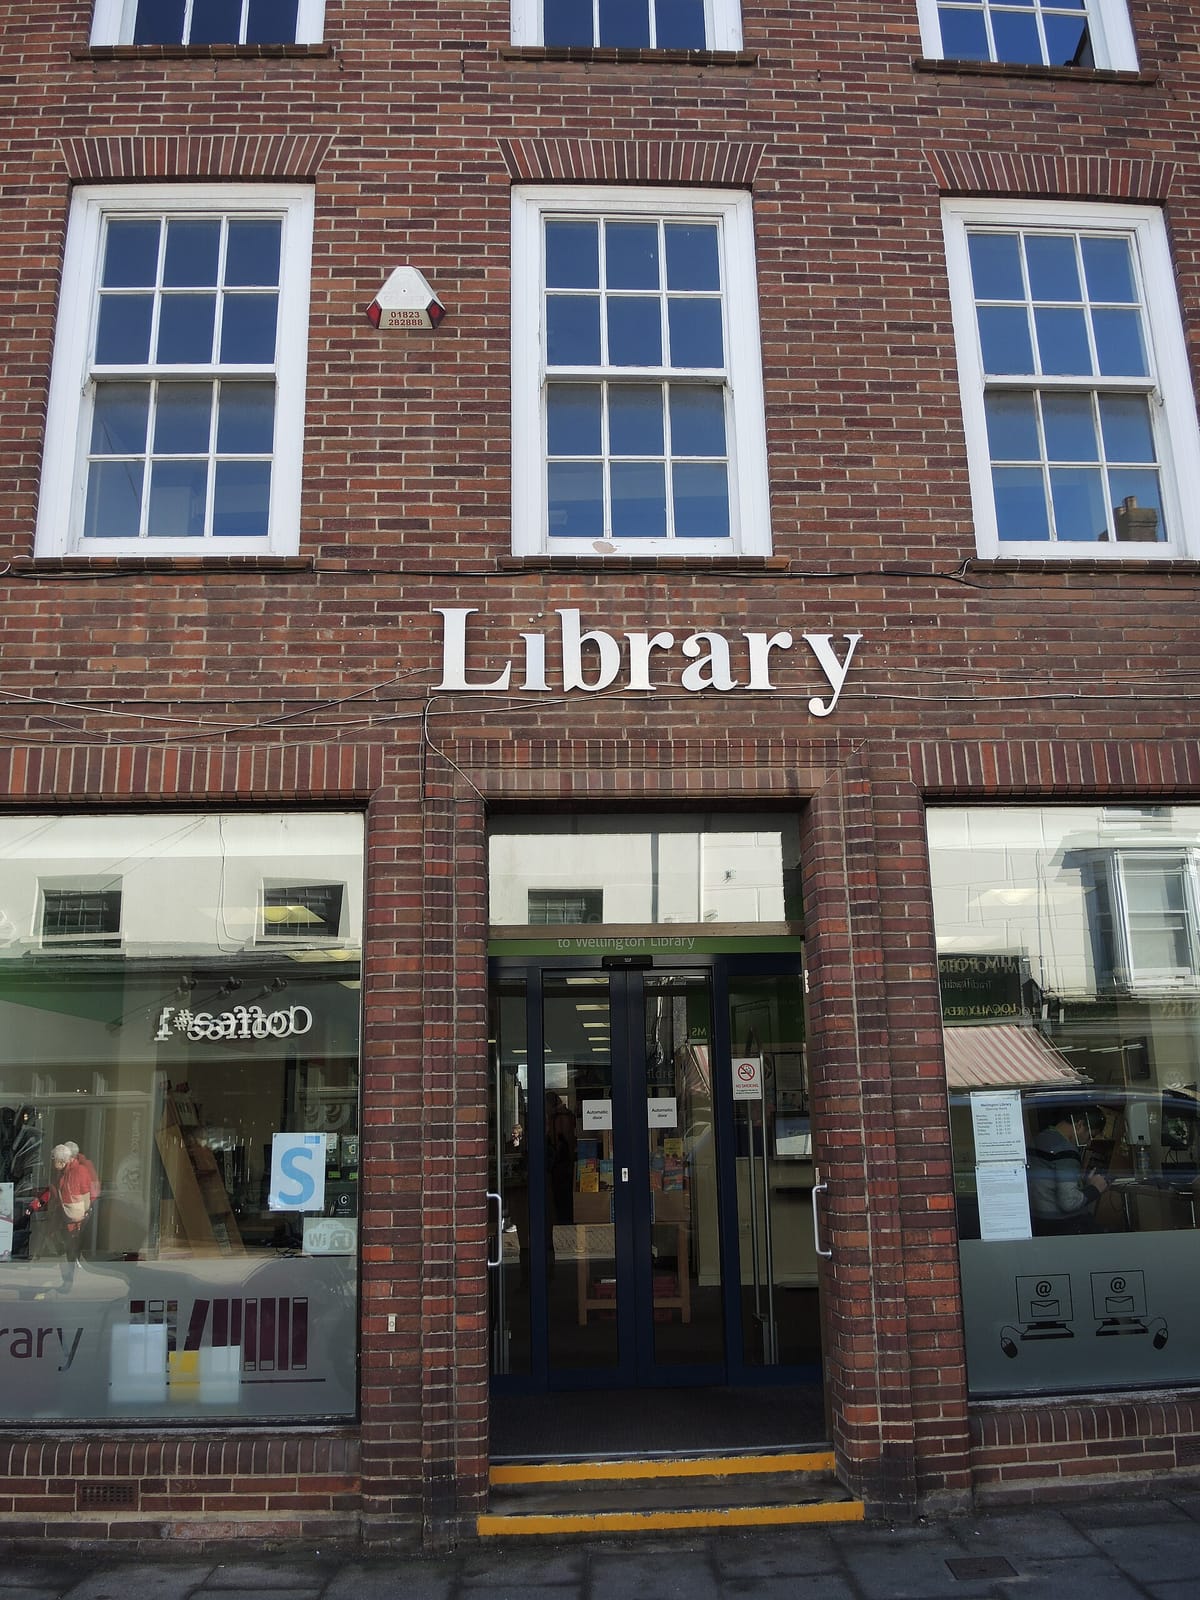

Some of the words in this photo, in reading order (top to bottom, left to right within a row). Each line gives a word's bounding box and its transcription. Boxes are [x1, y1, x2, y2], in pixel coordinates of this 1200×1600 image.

[431, 607, 863, 718] Library
[557, 938, 570, 948] to
[575, 938, 646, 950] Wellington
[650, 937, 695, 949] Library
[279, 1147, 315, 1205] S
